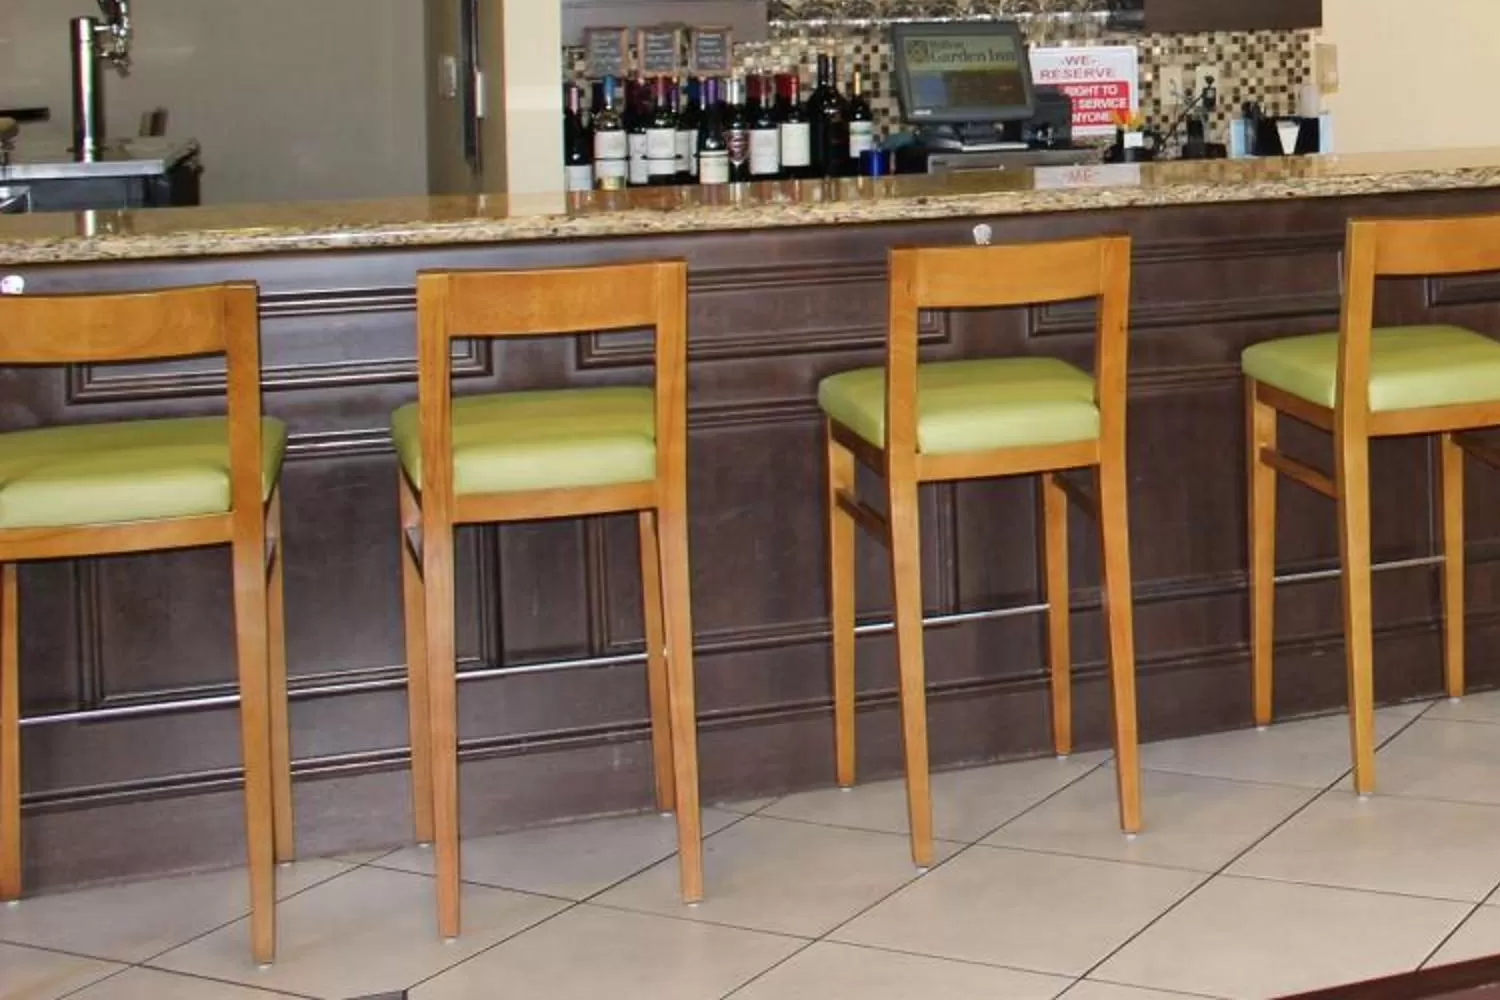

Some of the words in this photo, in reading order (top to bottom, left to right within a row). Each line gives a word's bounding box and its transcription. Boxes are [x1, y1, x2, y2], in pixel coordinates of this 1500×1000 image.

[1040, 67, 1116, 80] RESERVE
[1064, 84, 1098, 97] RIGHT
[1099, 84, 1118, 96] TO
[1077, 96, 1127, 110] SERVICE
